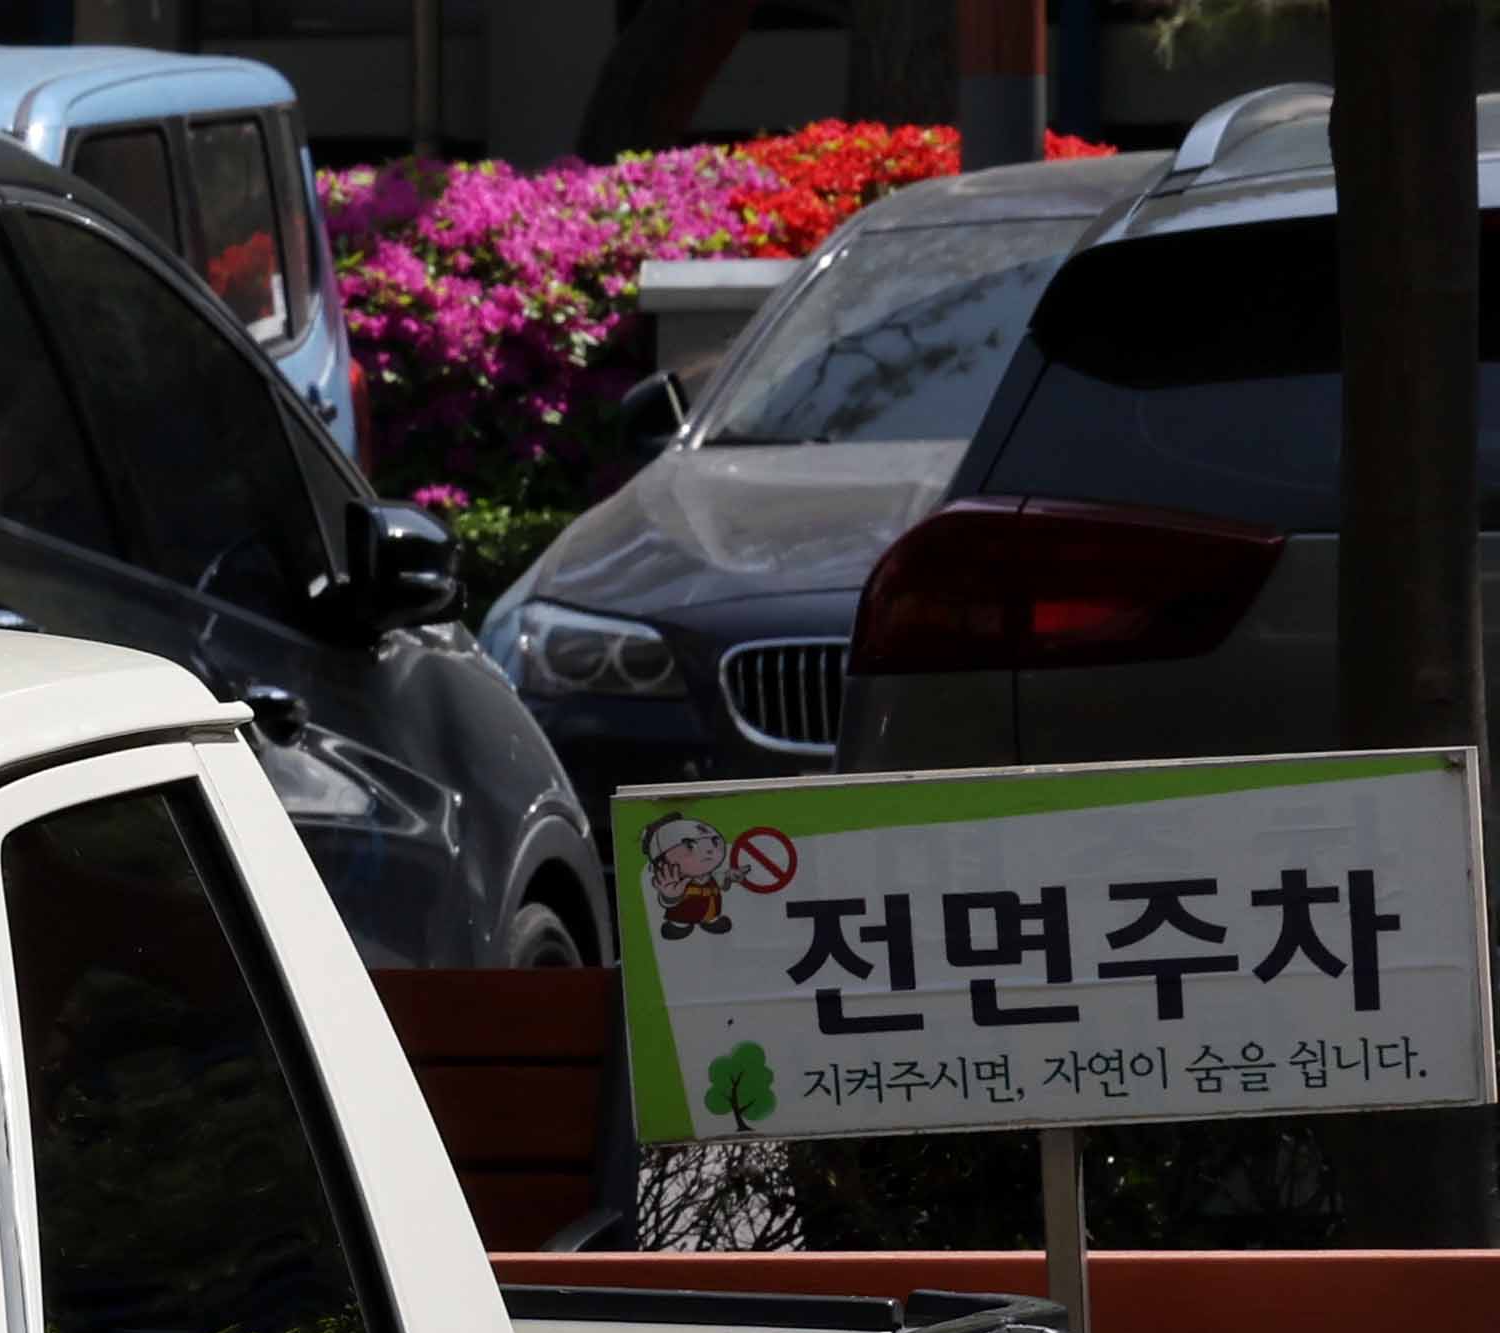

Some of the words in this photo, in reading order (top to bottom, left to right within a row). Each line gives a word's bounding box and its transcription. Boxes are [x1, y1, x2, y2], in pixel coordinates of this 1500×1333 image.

[785, 867, 1401, 1036] 전면주차
[802, 1053, 1026, 1107] 지켜주시면,
[1042, 1046, 1169, 1098] 자연이
[1184, 1042, 1278, 1094] 숨을
[1288, 1034, 1429, 1091] 쉽니다.
